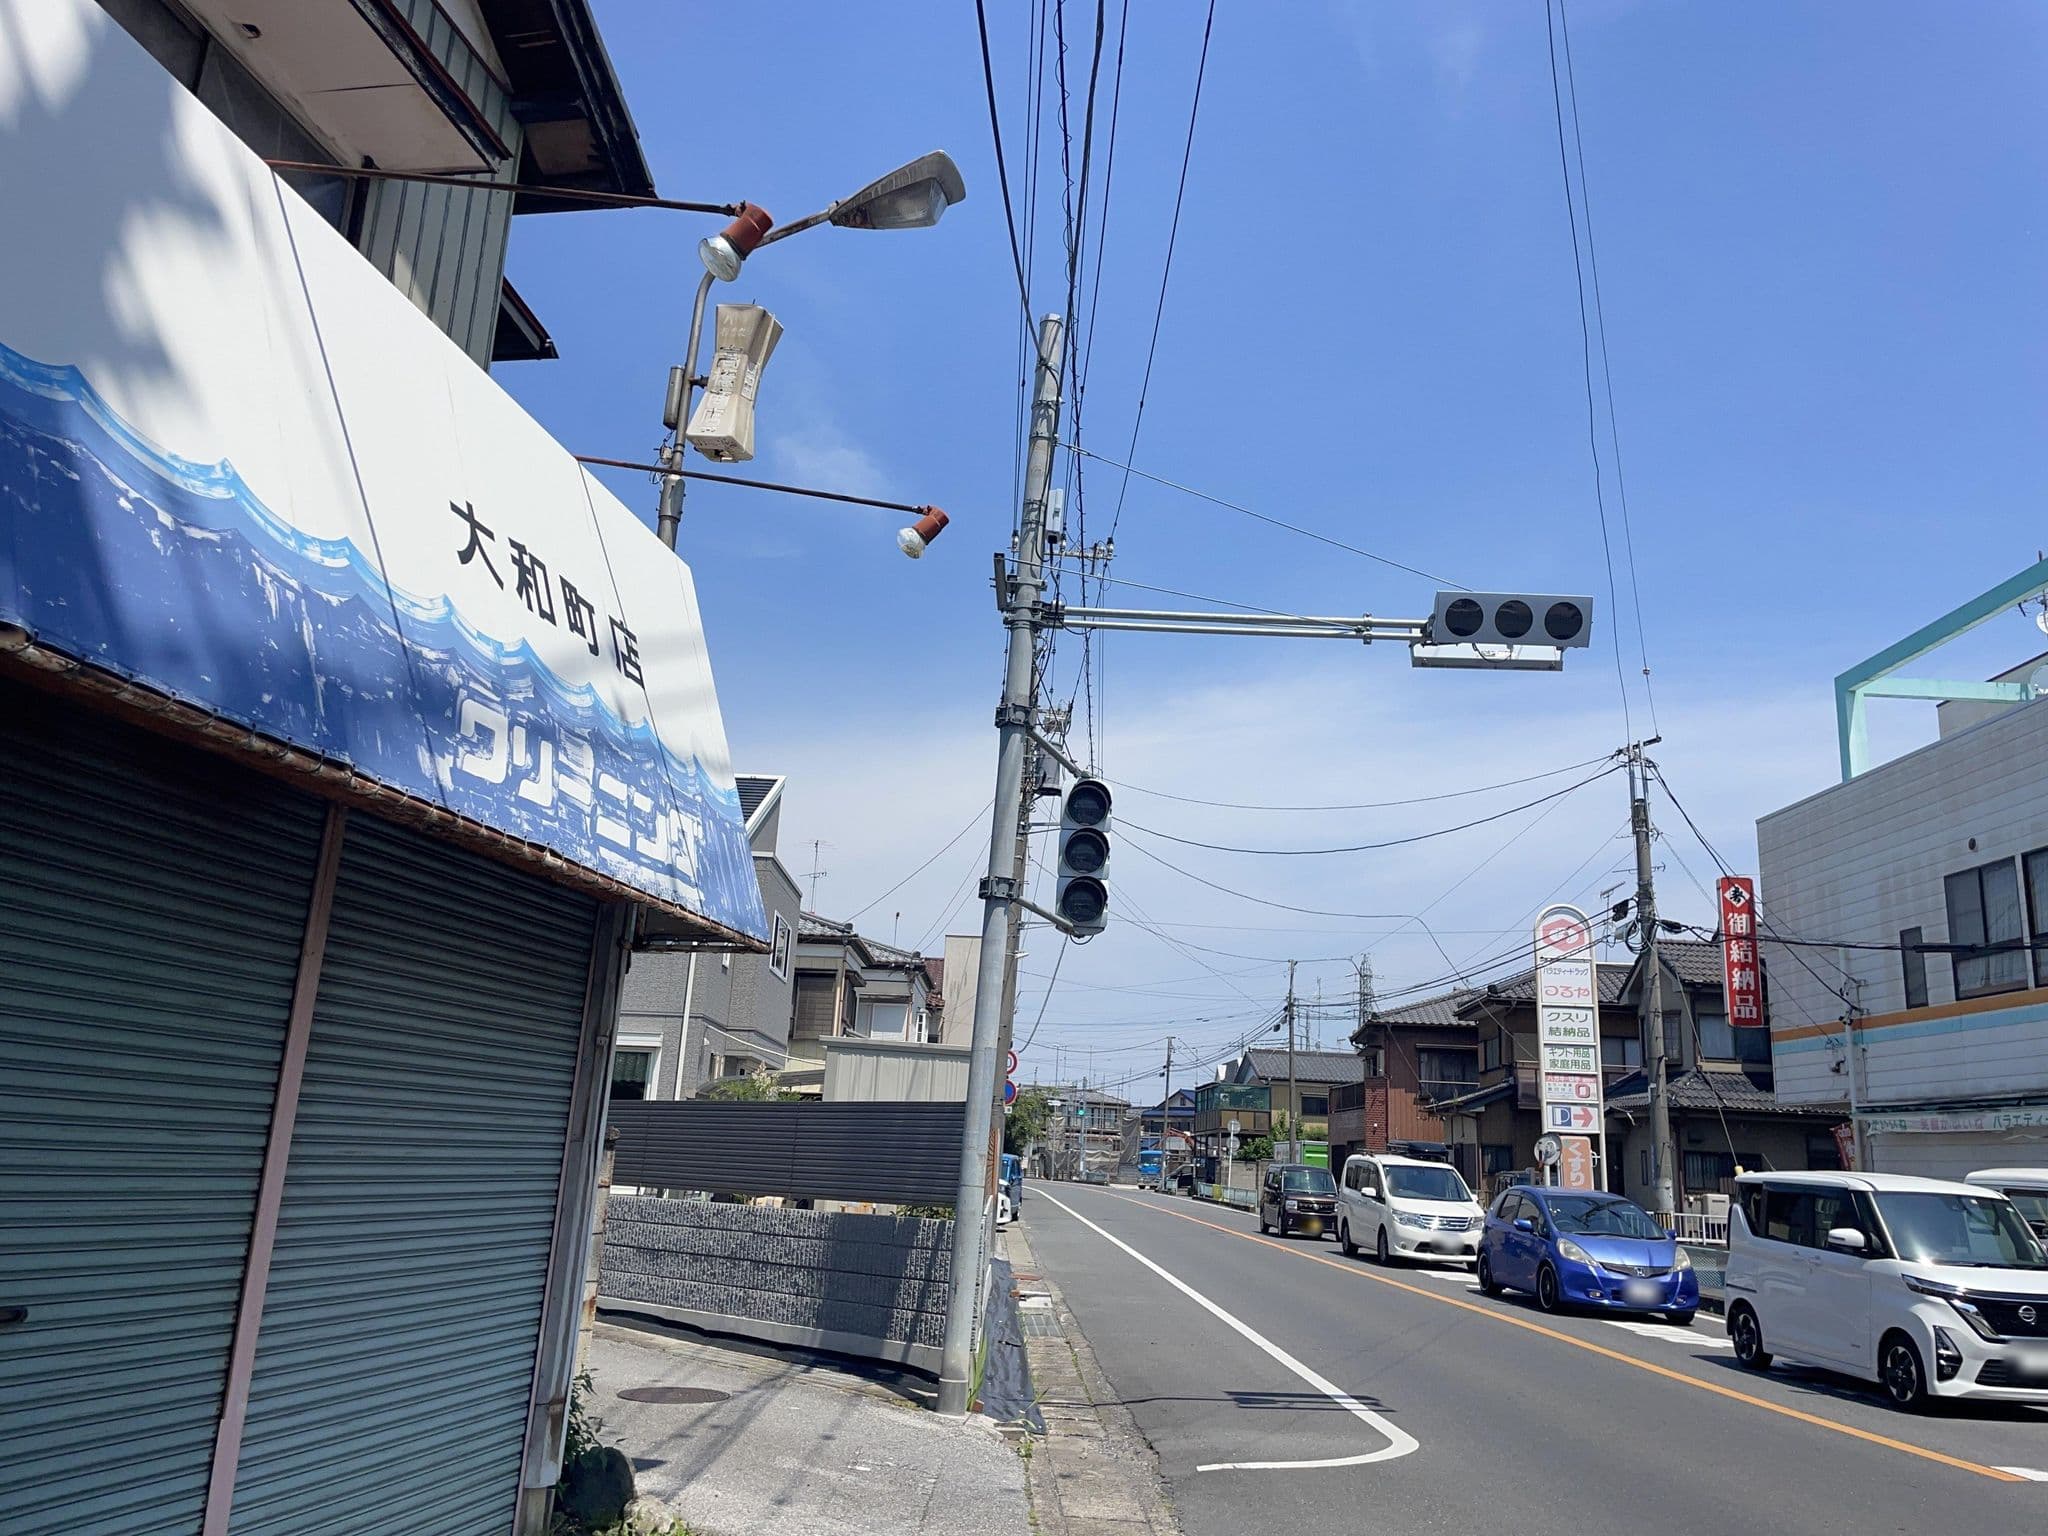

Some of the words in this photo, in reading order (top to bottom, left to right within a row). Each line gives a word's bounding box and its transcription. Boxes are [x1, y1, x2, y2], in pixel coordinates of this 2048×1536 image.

[448, 499, 645, 690] 大和町店
[1727, 912, 1758, 1019] 御結納品
[1544, 985, 1591, 998] つるや
[1547, 1012, 1589, 1023] クスリ
[1548, 1026, 1591, 1037] 結納品
[1548, 1047, 1591, 1058] ギフト用品
[1549, 1058, 1592, 1070] 家庭用品
[1553, 1107, 1570, 1125] P
[1567, 1141, 1586, 1187] くすり
